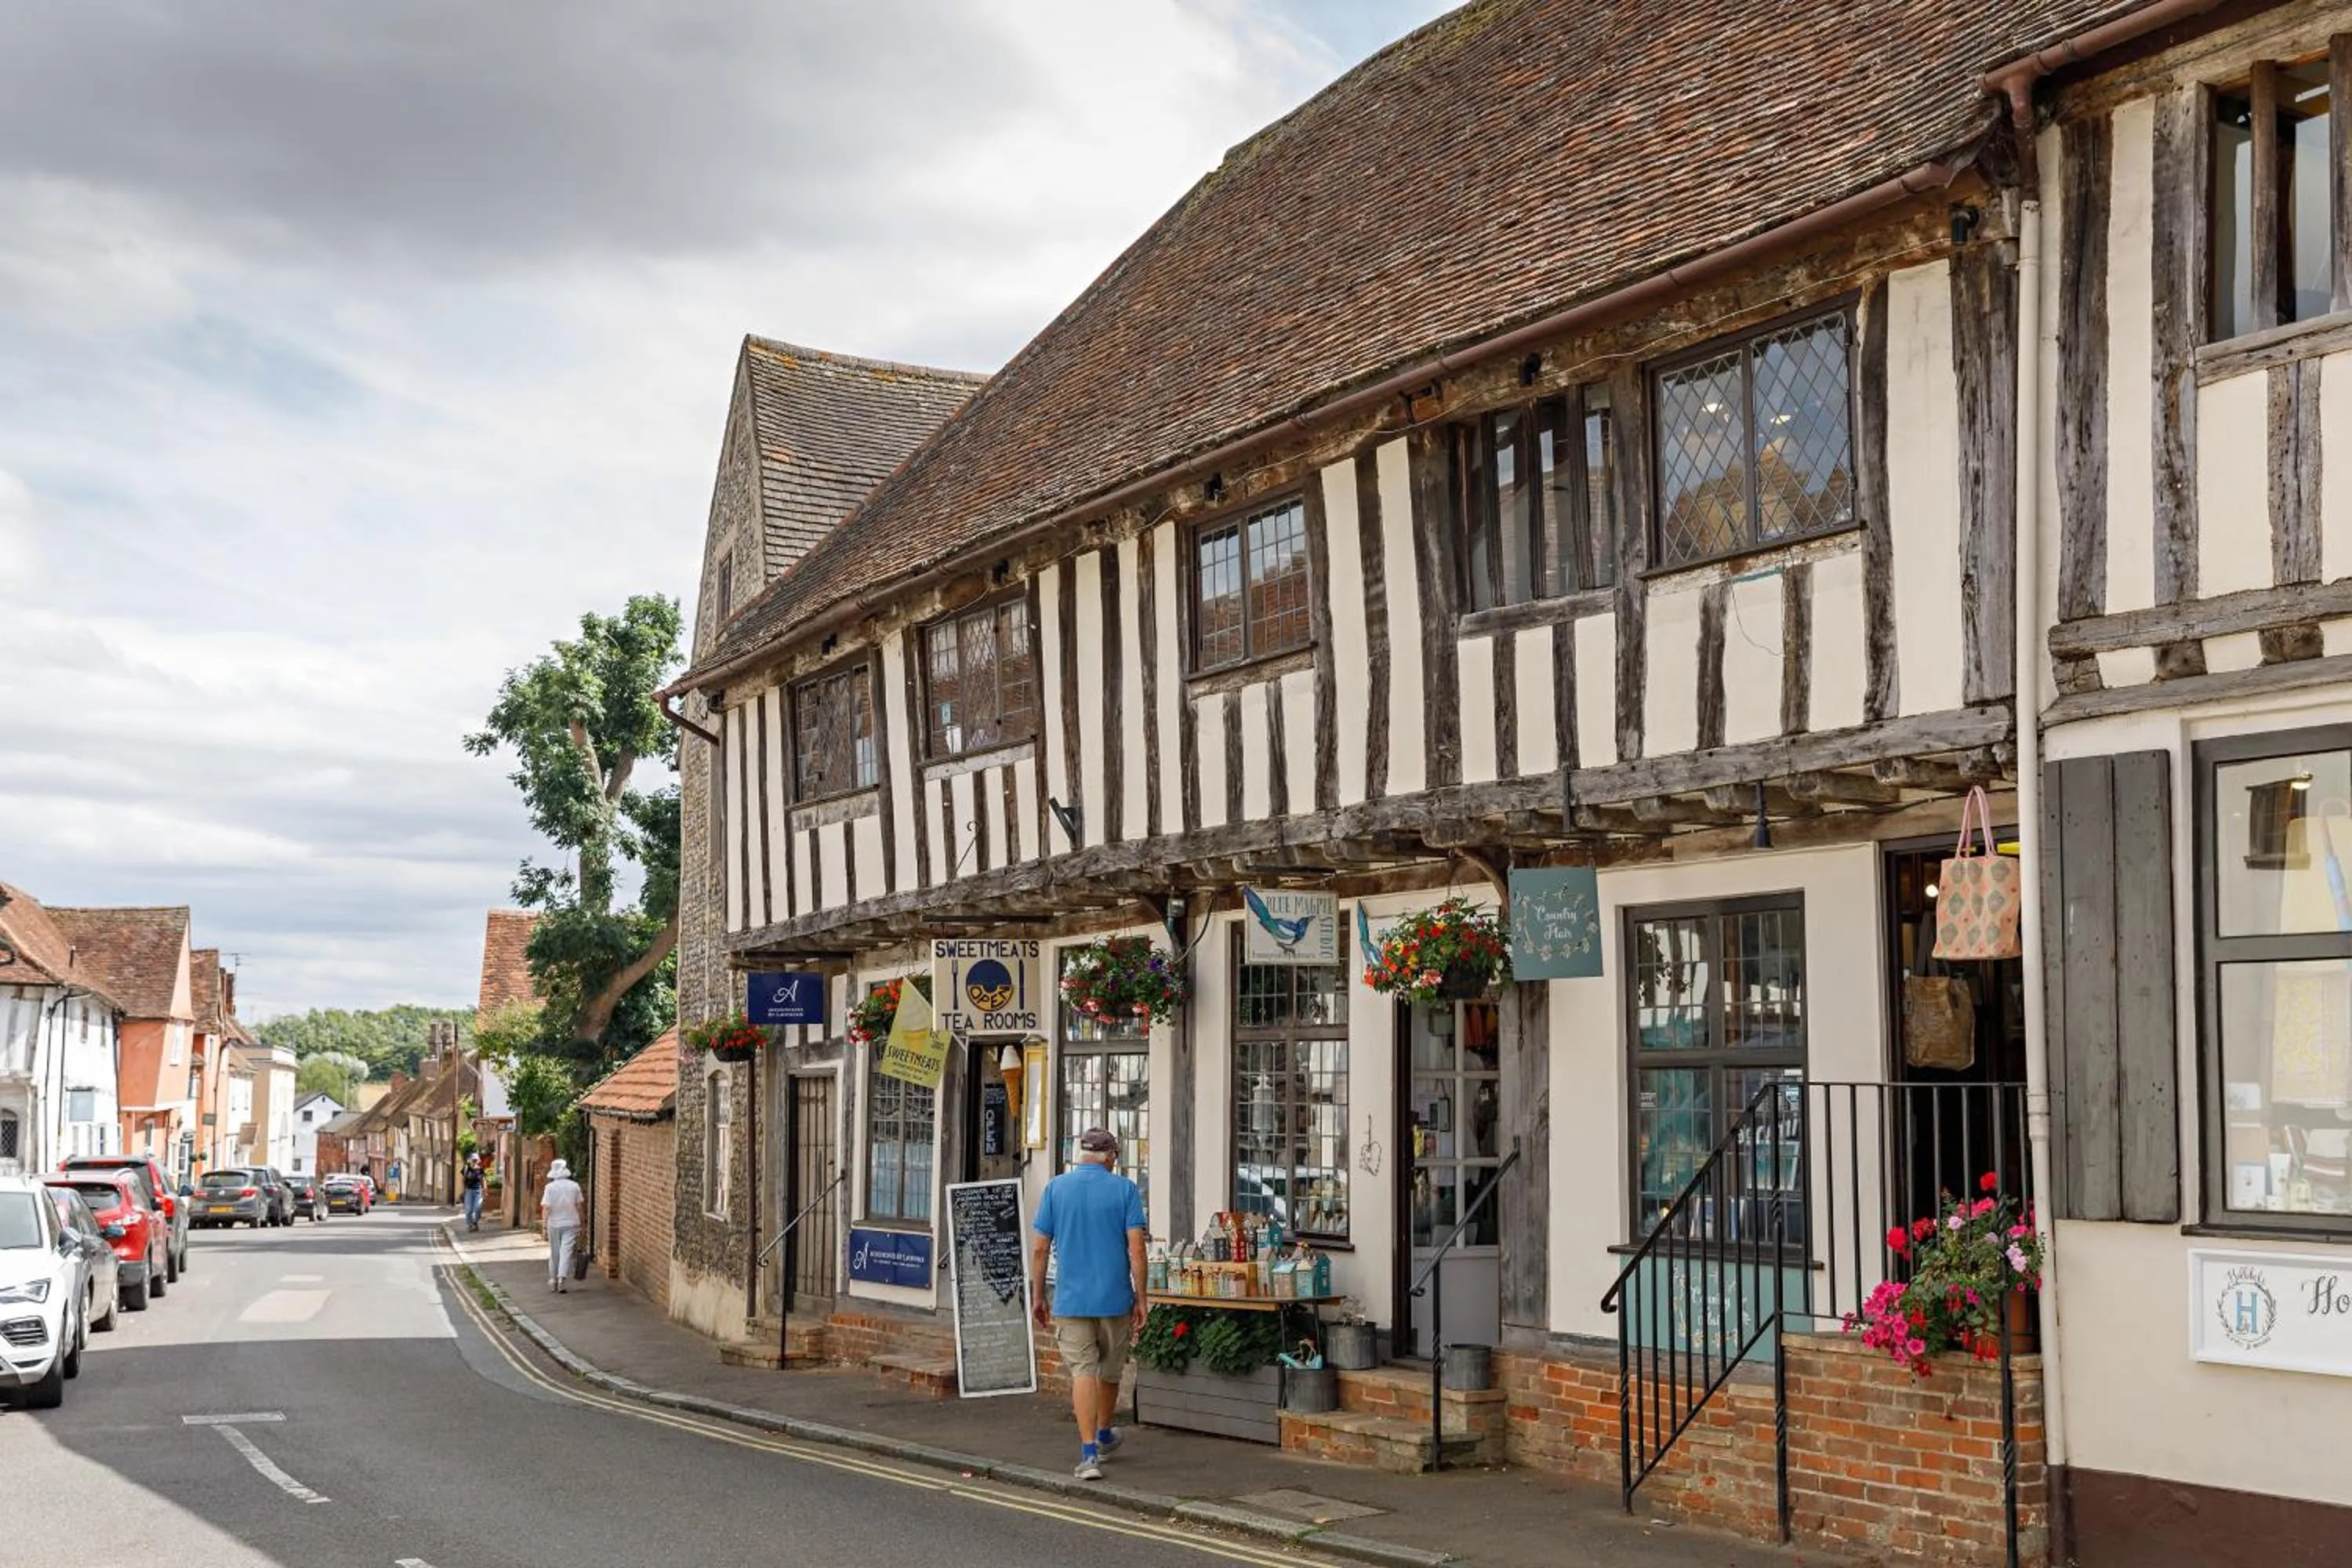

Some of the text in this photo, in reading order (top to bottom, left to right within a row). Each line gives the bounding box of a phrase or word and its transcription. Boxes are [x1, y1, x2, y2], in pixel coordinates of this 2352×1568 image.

[1266, 896, 1333, 915] BLUE MAGPIE
[1531, 906, 1577, 925] Country
[1543, 922, 1573, 942] Flair
[935, 940, 1039, 957] SWEETMEATS
[970, 985, 1011, 1009] OPEN
[942, 1011, 1036, 1029] TEA ROOMS
